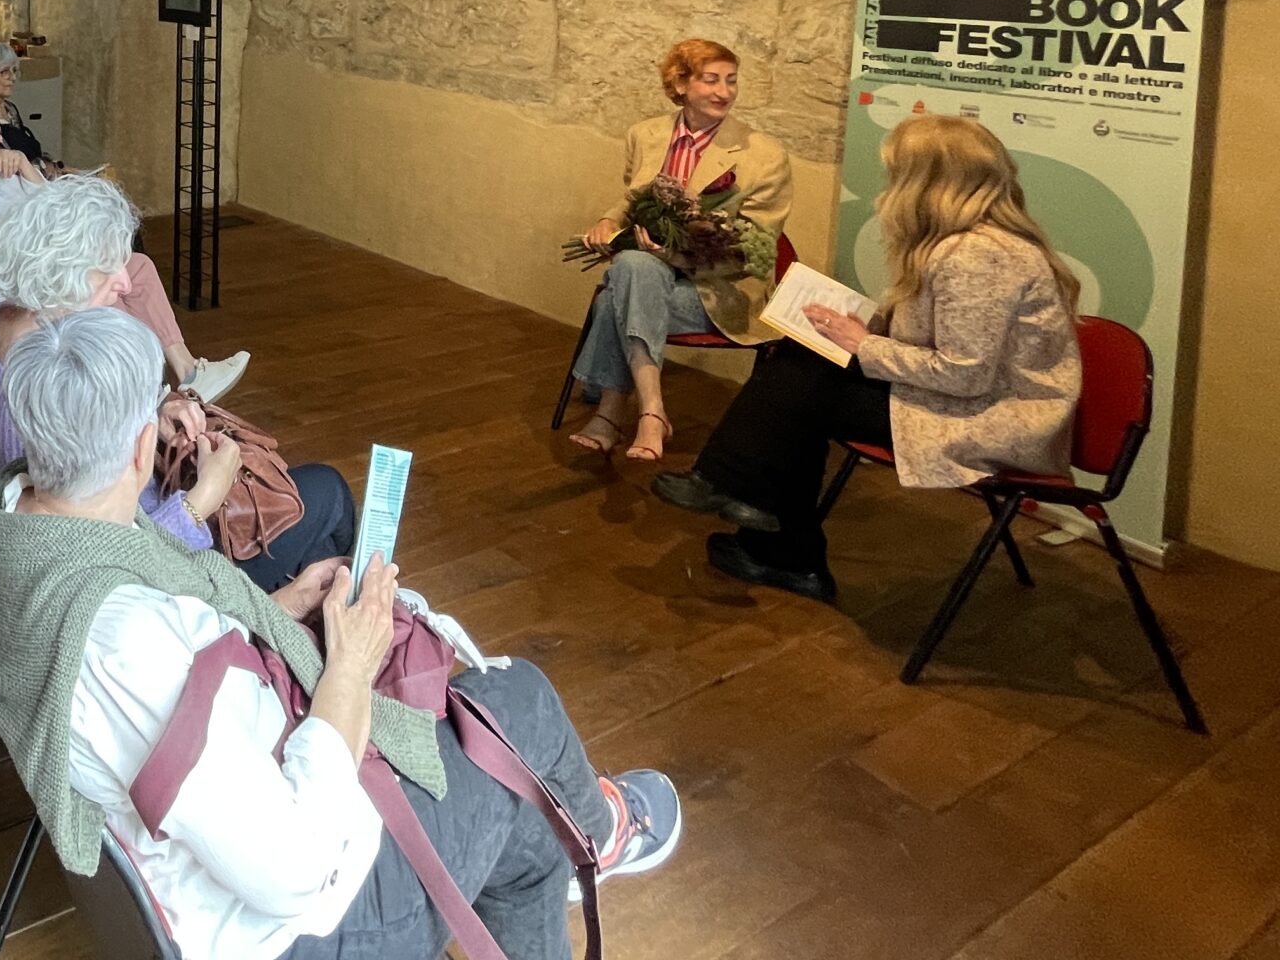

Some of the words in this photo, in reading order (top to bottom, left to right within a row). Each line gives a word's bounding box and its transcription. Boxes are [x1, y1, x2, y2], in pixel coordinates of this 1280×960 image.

[938, 21, 1185, 73] FESTIVAL
[861, 64, 945, 82] Presentazioni,
[949, 73, 1006, 88] incontri,
[1010, 79, 1084, 95] laboratori
[1088, 88, 1098, 96] e
[1103, 90, 1161, 104] mostre
[862, 51, 907, 64] Festival
[911, 55, 953, 68] diffuso
[957, 59, 1016, 74] dedicato
[1021, 66, 1034, 75] al
[1039, 66, 1073, 80] libro
[1079, 72, 1088, 80] e
[1093, 73, 1120, 84] alla
[1125, 74, 1184, 90] lettura
